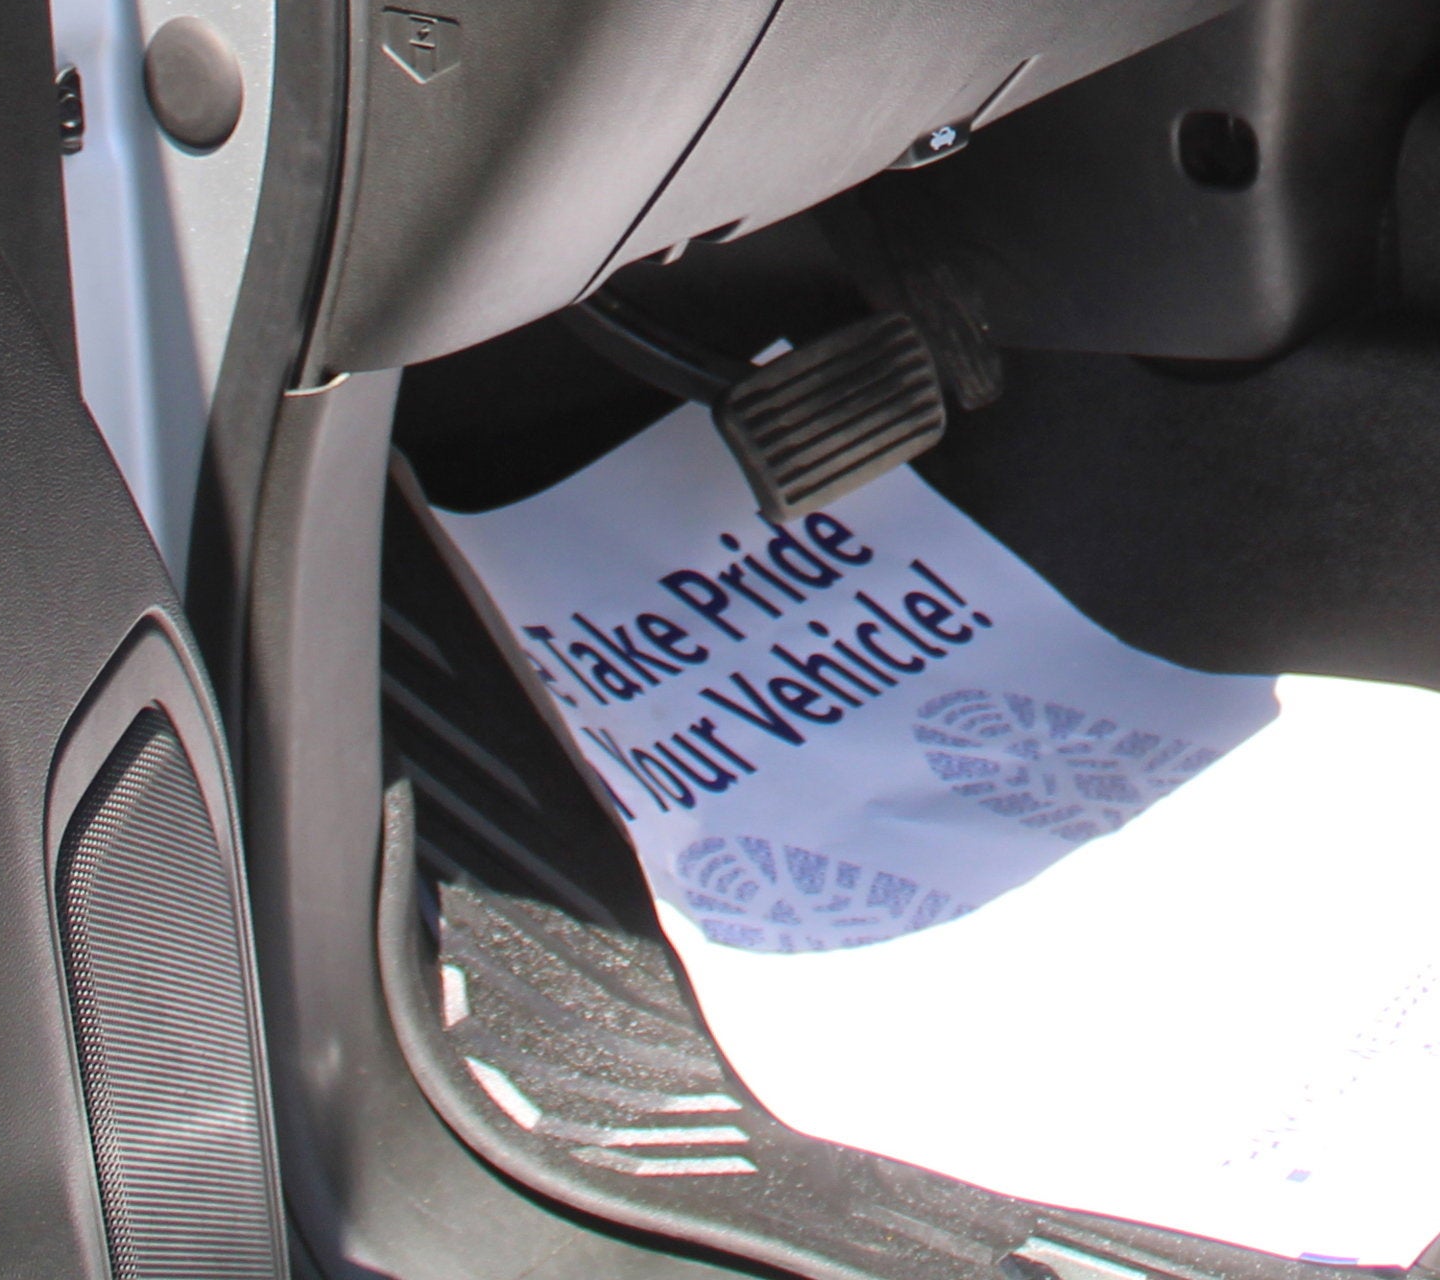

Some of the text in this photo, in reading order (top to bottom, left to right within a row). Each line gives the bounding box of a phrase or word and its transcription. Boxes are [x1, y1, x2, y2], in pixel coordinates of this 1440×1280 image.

[657, 510, 875, 642] Pride
[582, 717, 758, 813] Your
[698, 557, 995, 748] Vehicle!
